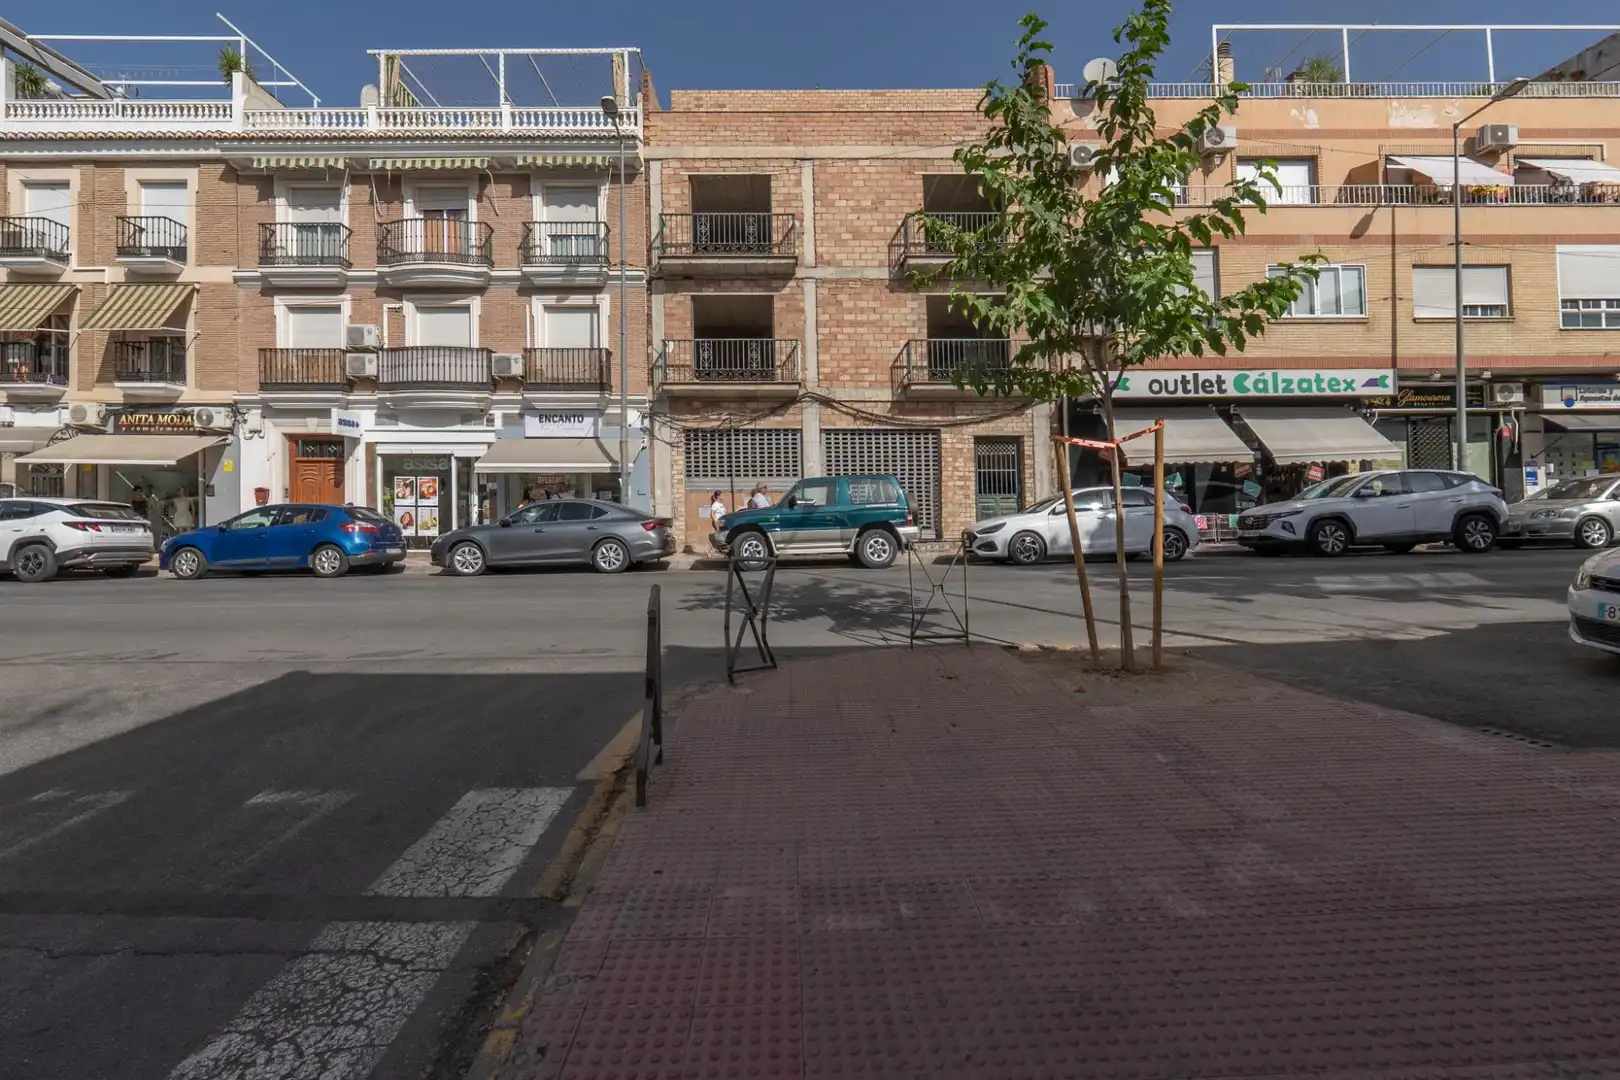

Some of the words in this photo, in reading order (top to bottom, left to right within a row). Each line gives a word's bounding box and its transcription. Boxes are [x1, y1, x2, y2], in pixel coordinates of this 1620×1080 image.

[1148, 373, 1227, 395] outlet
[119, 414, 154, 425] ANITA
[156, 414, 194, 425] MODA
[538, 413, 584, 424] ENCANTO
[403, 458, 449, 470] asisa
